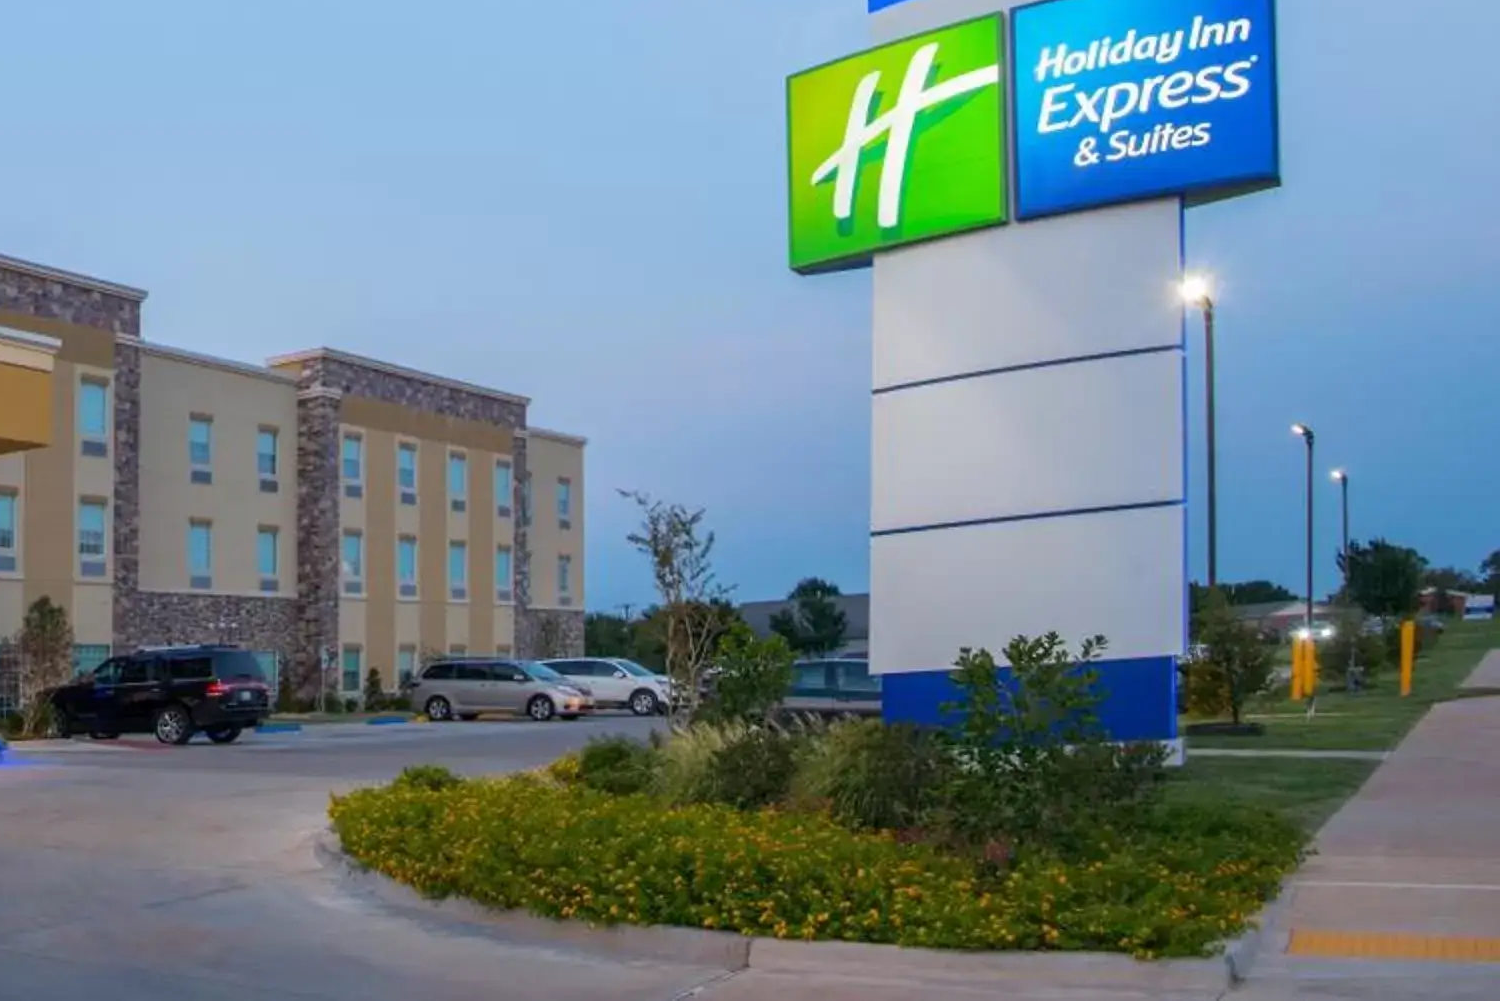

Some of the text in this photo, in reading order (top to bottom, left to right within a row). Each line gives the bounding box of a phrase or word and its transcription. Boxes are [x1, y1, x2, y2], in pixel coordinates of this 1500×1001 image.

[1034, 15, 1251, 83] Holiday Inn
[1037, 60, 1252, 133] Express
[1073, 122, 1212, 167] & Suites
